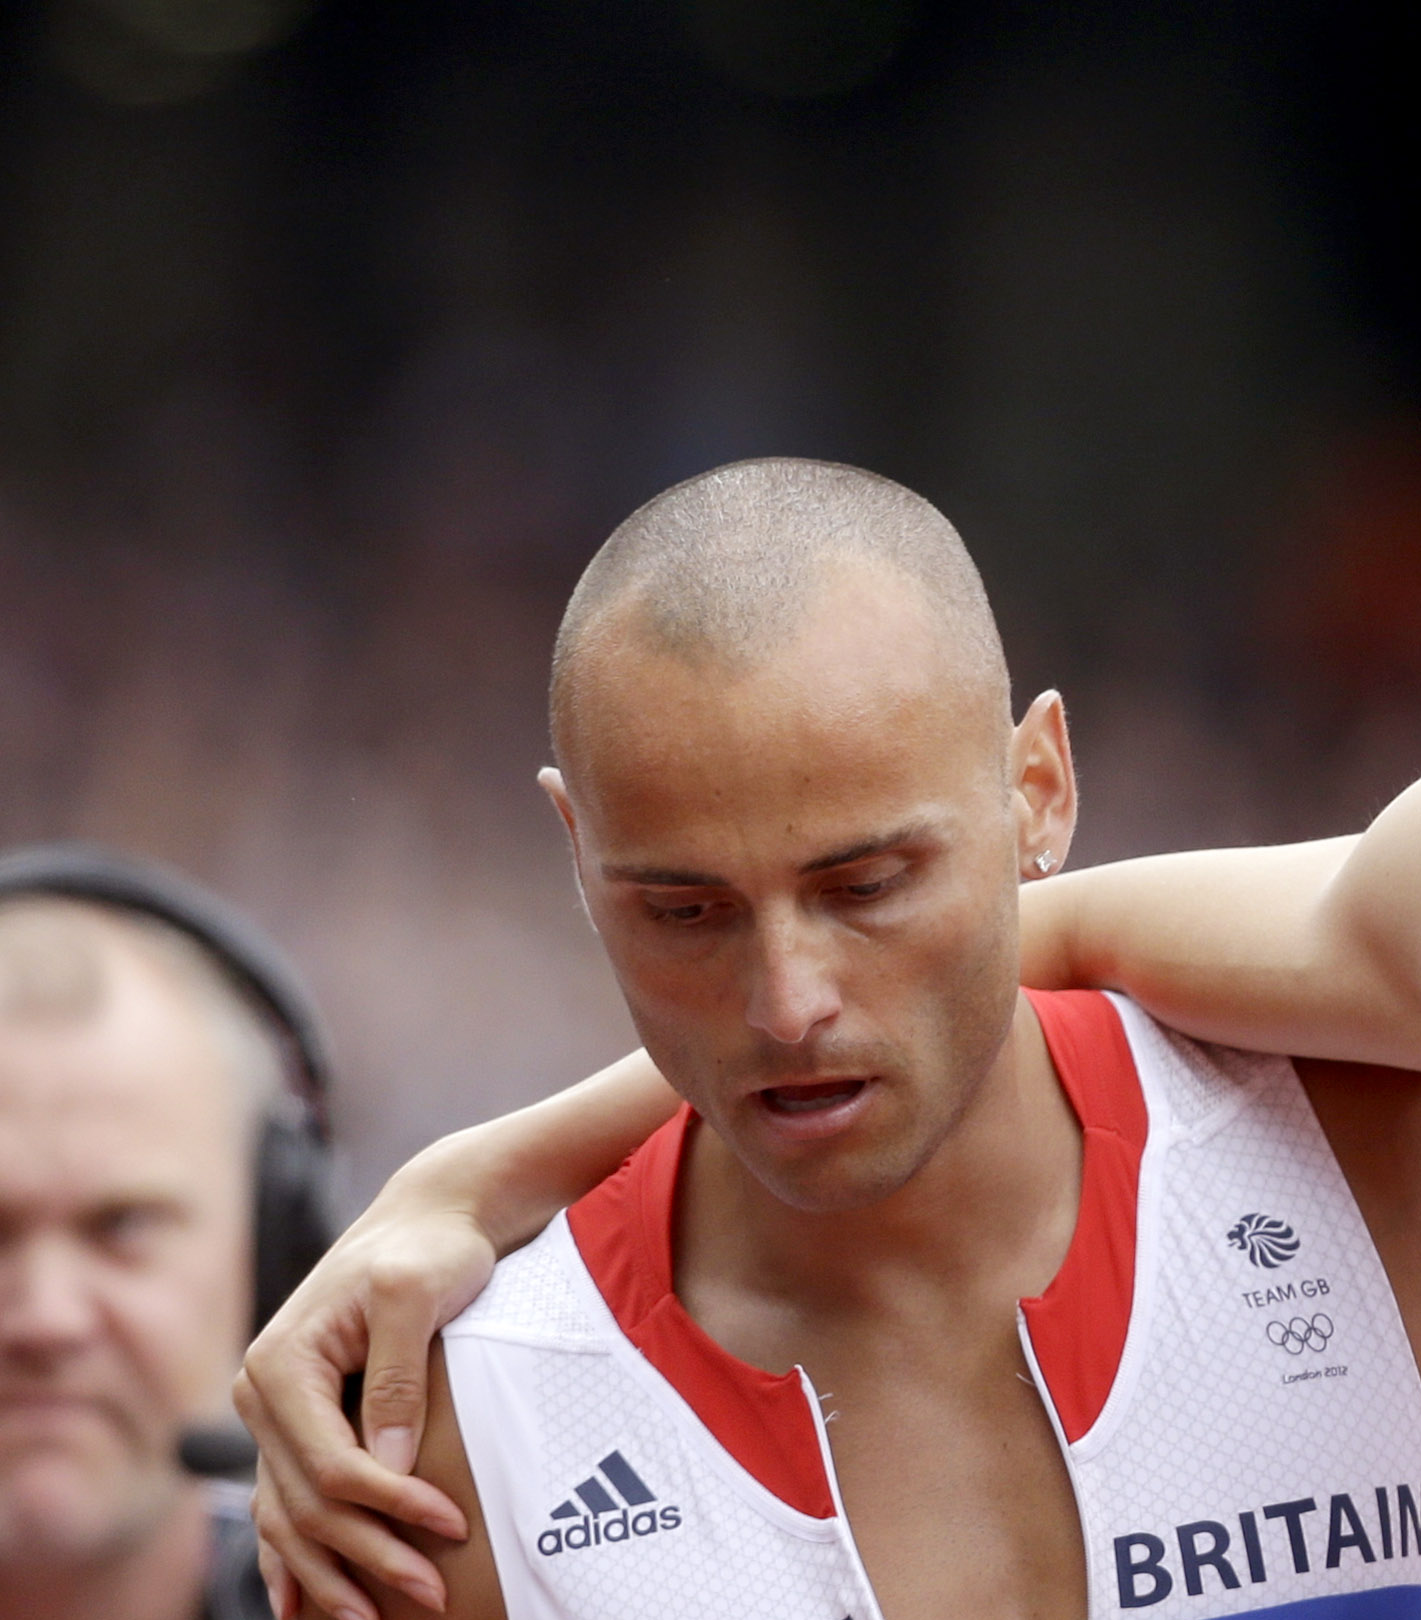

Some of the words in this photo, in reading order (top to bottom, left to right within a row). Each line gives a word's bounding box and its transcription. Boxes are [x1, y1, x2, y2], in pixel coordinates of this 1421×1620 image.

[1242, 1284, 1297, 1309] TEAM
[1301, 1278, 1331, 1298] GB
[1283, 1369, 1322, 1385] London
[1324, 1365, 1349, 1378] 2012
[537, 1499, 682, 1557] adidas
